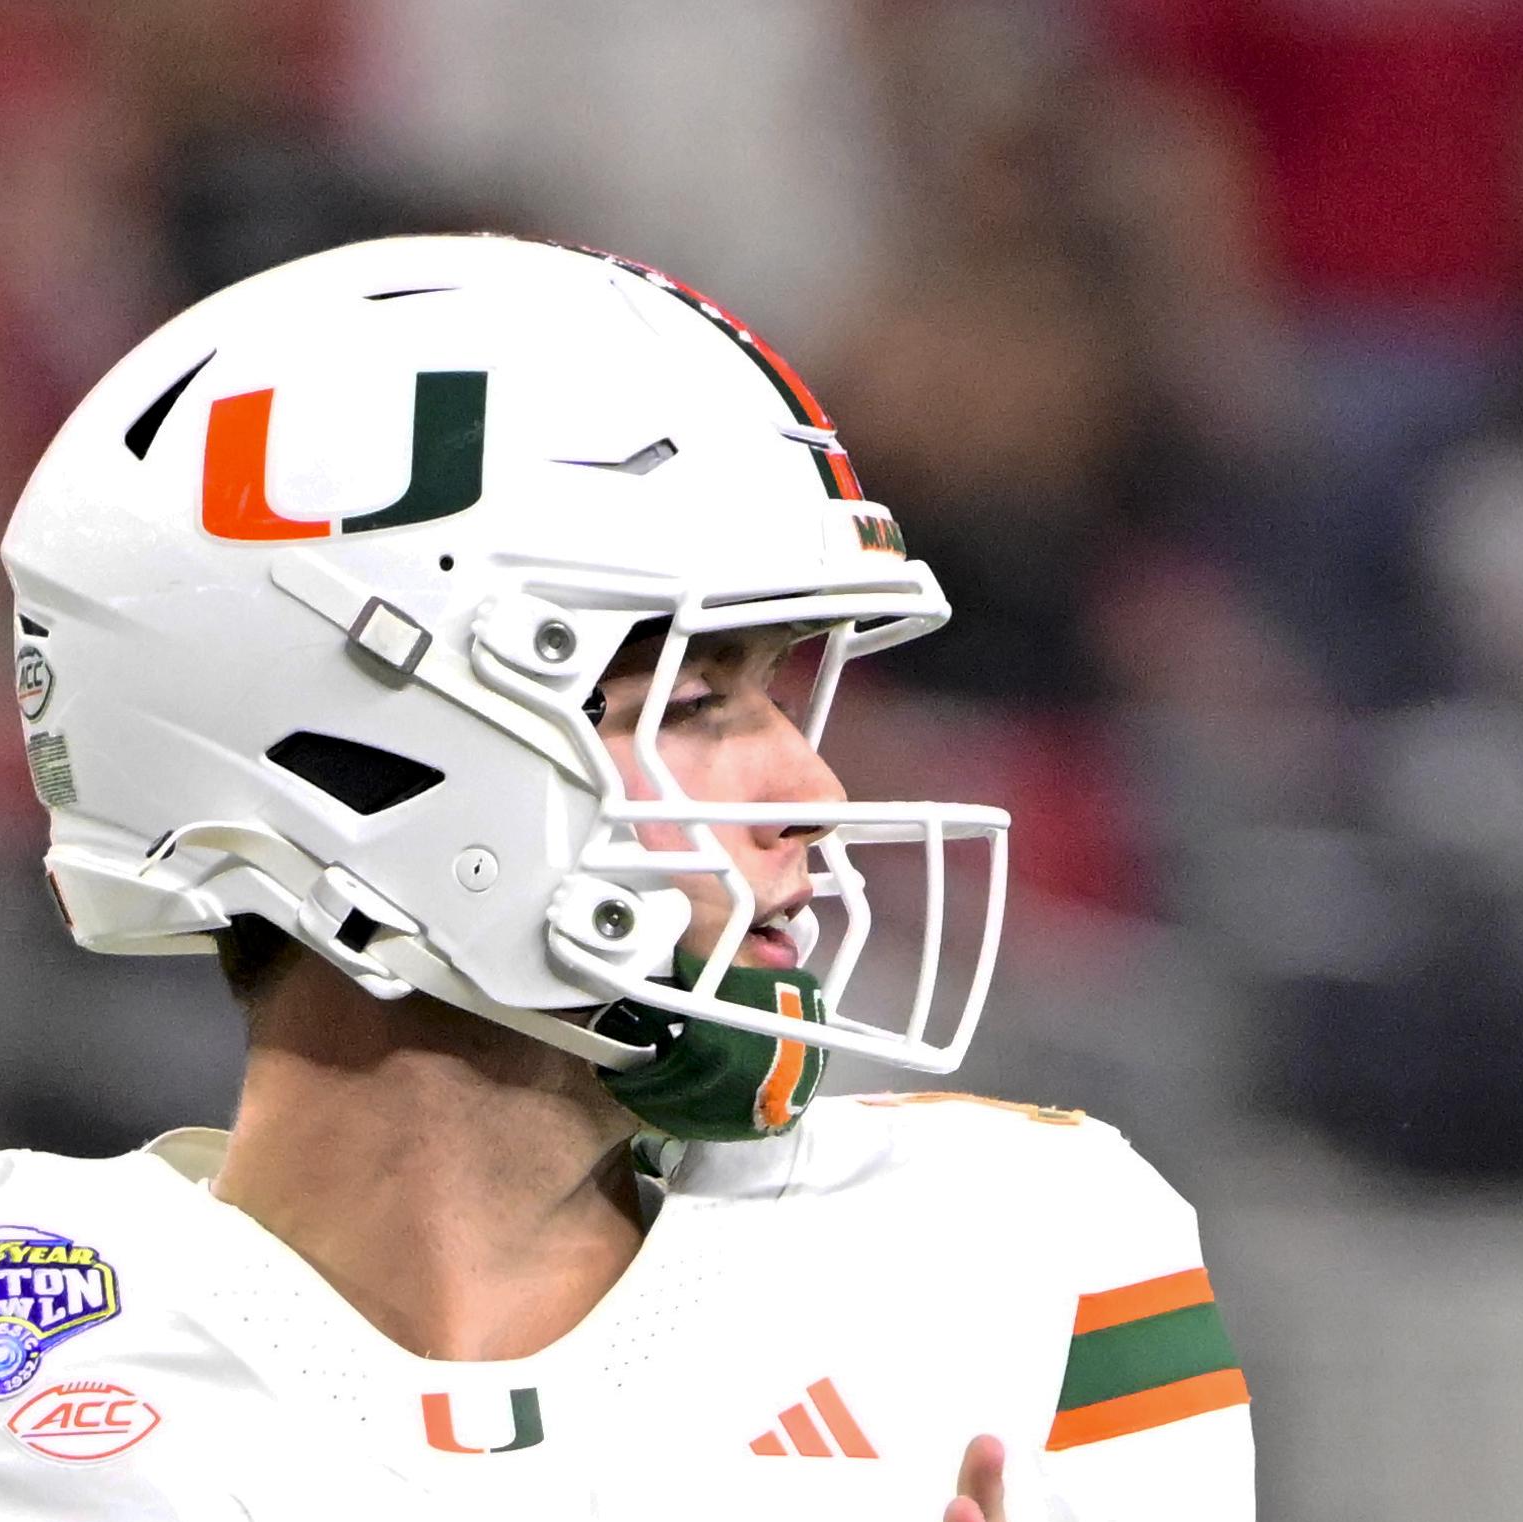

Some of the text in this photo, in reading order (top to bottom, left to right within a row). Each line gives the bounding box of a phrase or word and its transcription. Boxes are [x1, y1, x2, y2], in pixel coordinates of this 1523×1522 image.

[202, 370, 488, 540] U
[31, 1399, 140, 1431] ACC
[421, 1386, 545, 1455] U
